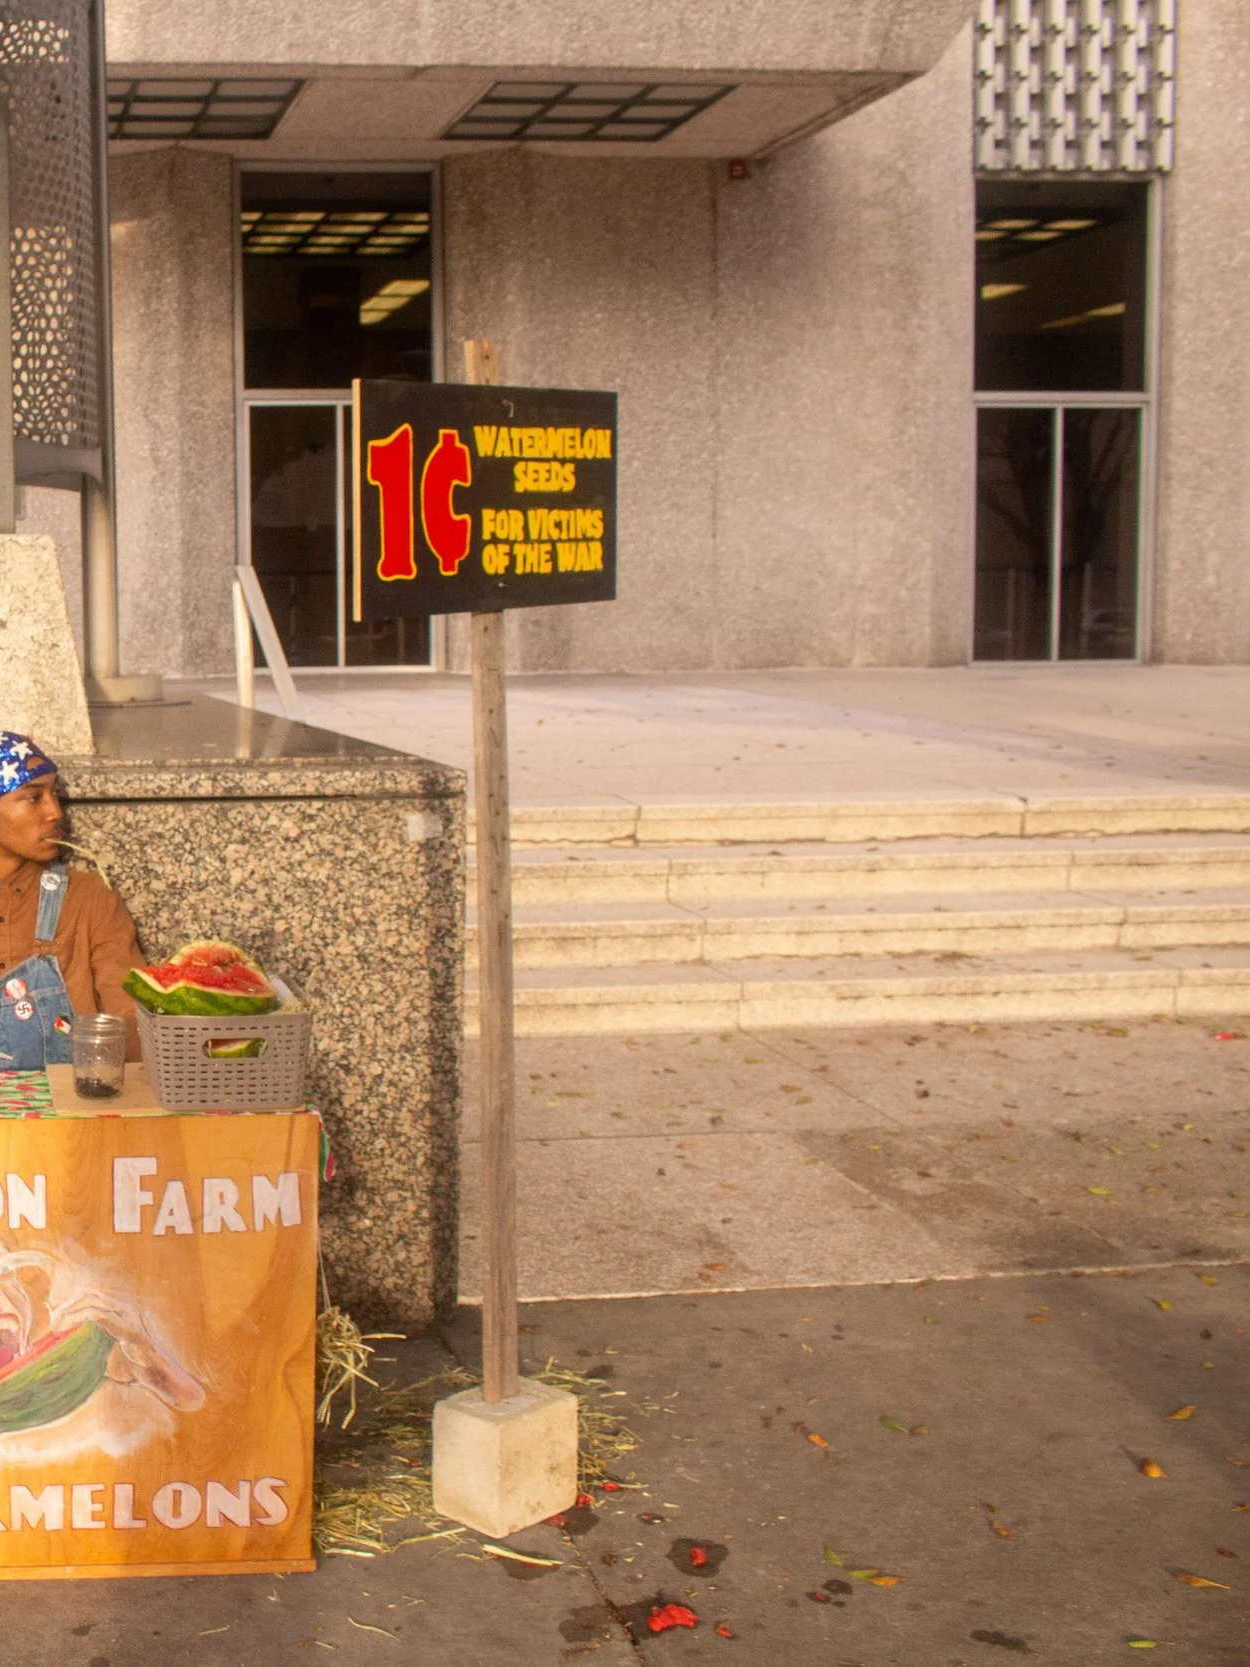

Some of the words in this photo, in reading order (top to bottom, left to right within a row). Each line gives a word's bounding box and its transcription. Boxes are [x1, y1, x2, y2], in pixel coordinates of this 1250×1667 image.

[473, 425, 612, 459] WATERMELON
[513, 460, 577, 493] SEEDS
[481, 507, 524, 541] FOR
[527, 507, 604, 541] VICTIMS
[481, 543, 510, 576] OF
[513, 542, 553, 575] THE
[555, 541, 604, 572] WAR
[112, 1156, 302, 1236] FARM
